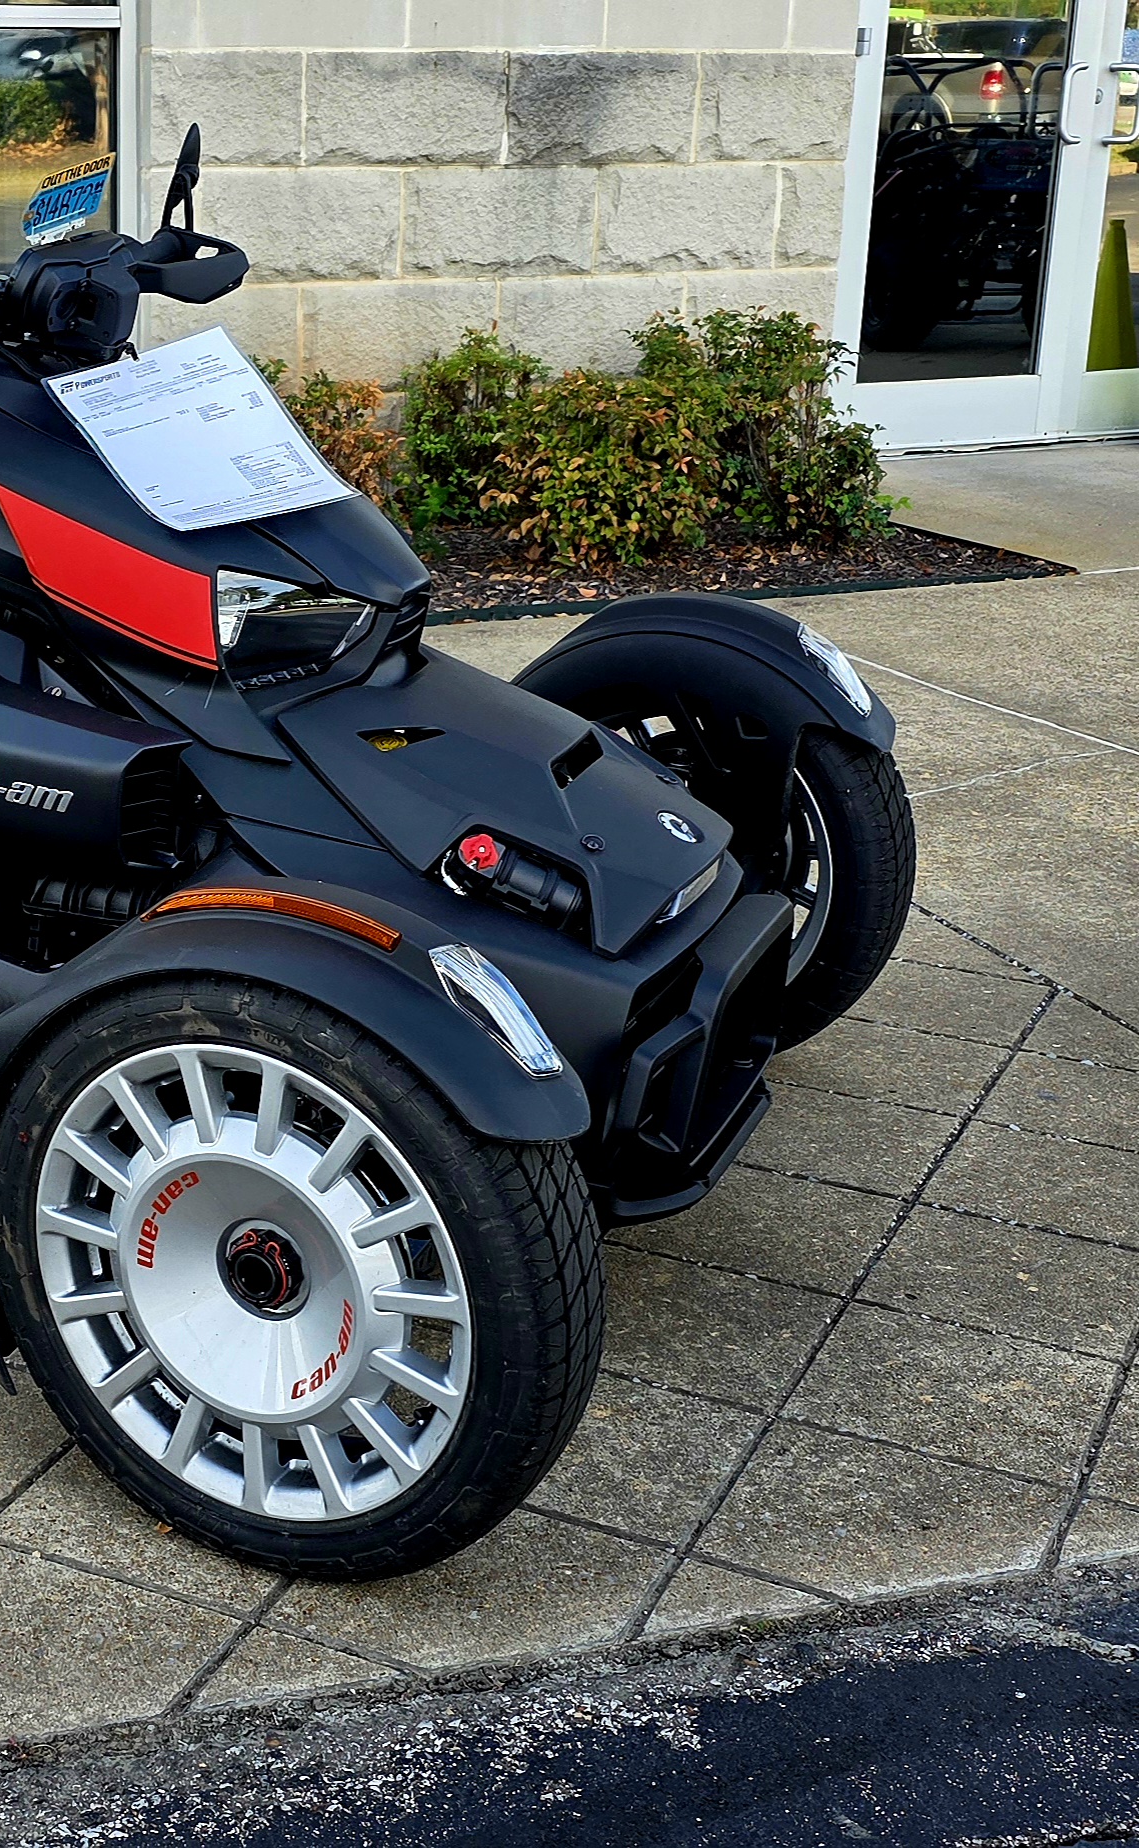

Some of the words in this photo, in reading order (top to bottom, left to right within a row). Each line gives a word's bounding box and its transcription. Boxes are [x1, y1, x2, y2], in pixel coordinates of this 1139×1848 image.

[41, 171, 64, 189] OUT
[63, 164, 84, 181] THE
[83, 156, 110, 175] DOOR
[136, 1170, 202, 1269] can-am
[290, 1299, 354, 1400] can-am
